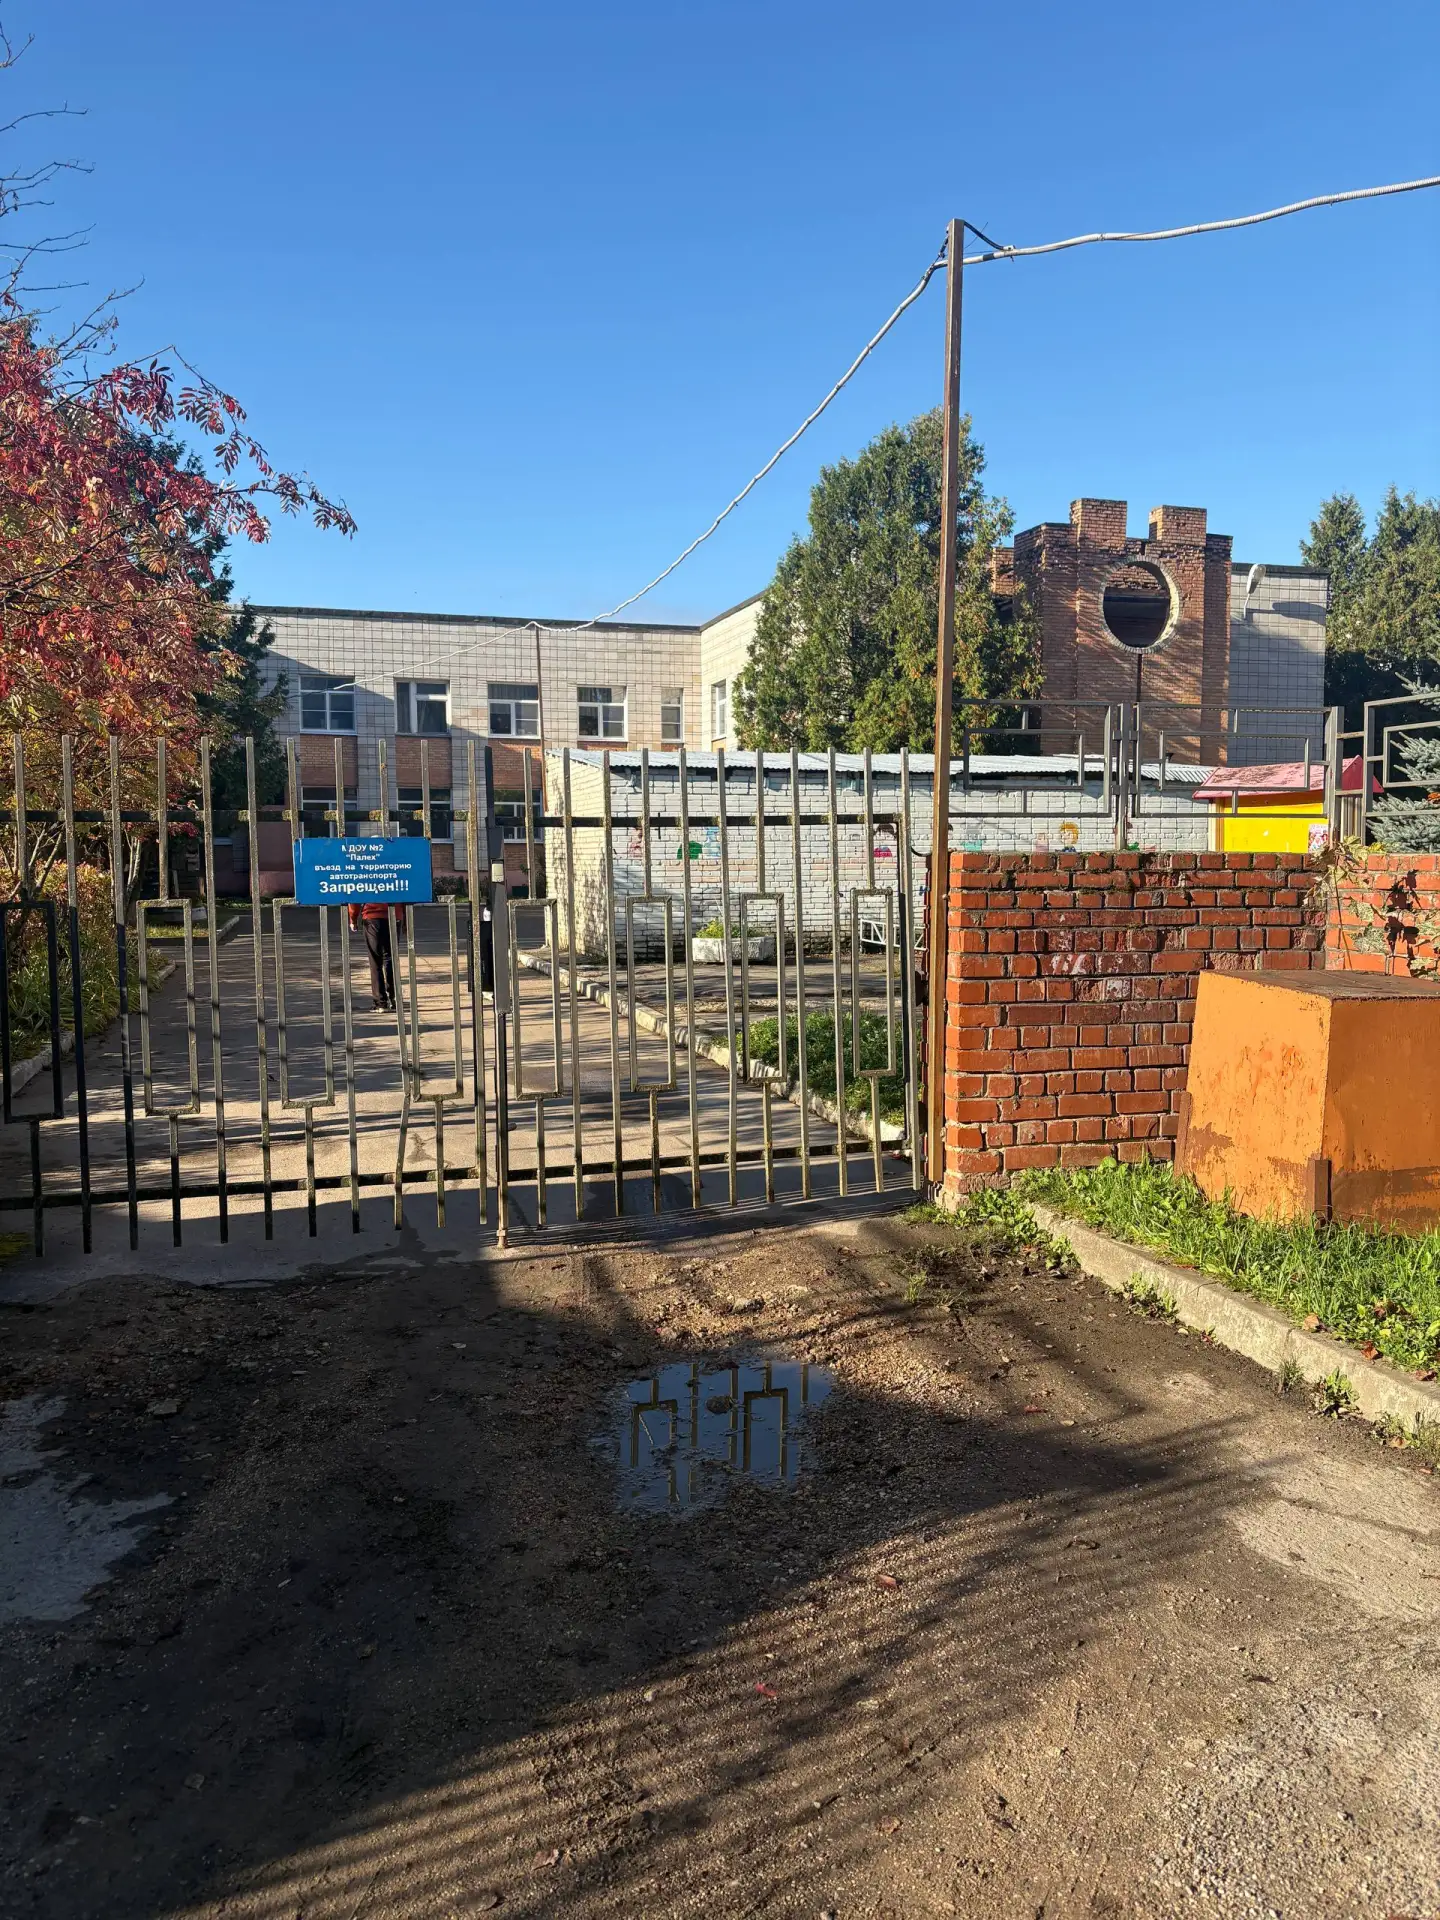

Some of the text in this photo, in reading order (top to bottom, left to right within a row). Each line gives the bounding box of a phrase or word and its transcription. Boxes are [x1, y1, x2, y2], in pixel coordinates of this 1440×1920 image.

[369, 844, 384, 852] №2
[314, 864, 341, 872] въезд
[360, 863, 412, 871] территорию
[329, 872, 398, 880] автотранспорта
[319, 880, 409, 895] Запрещен!!!
